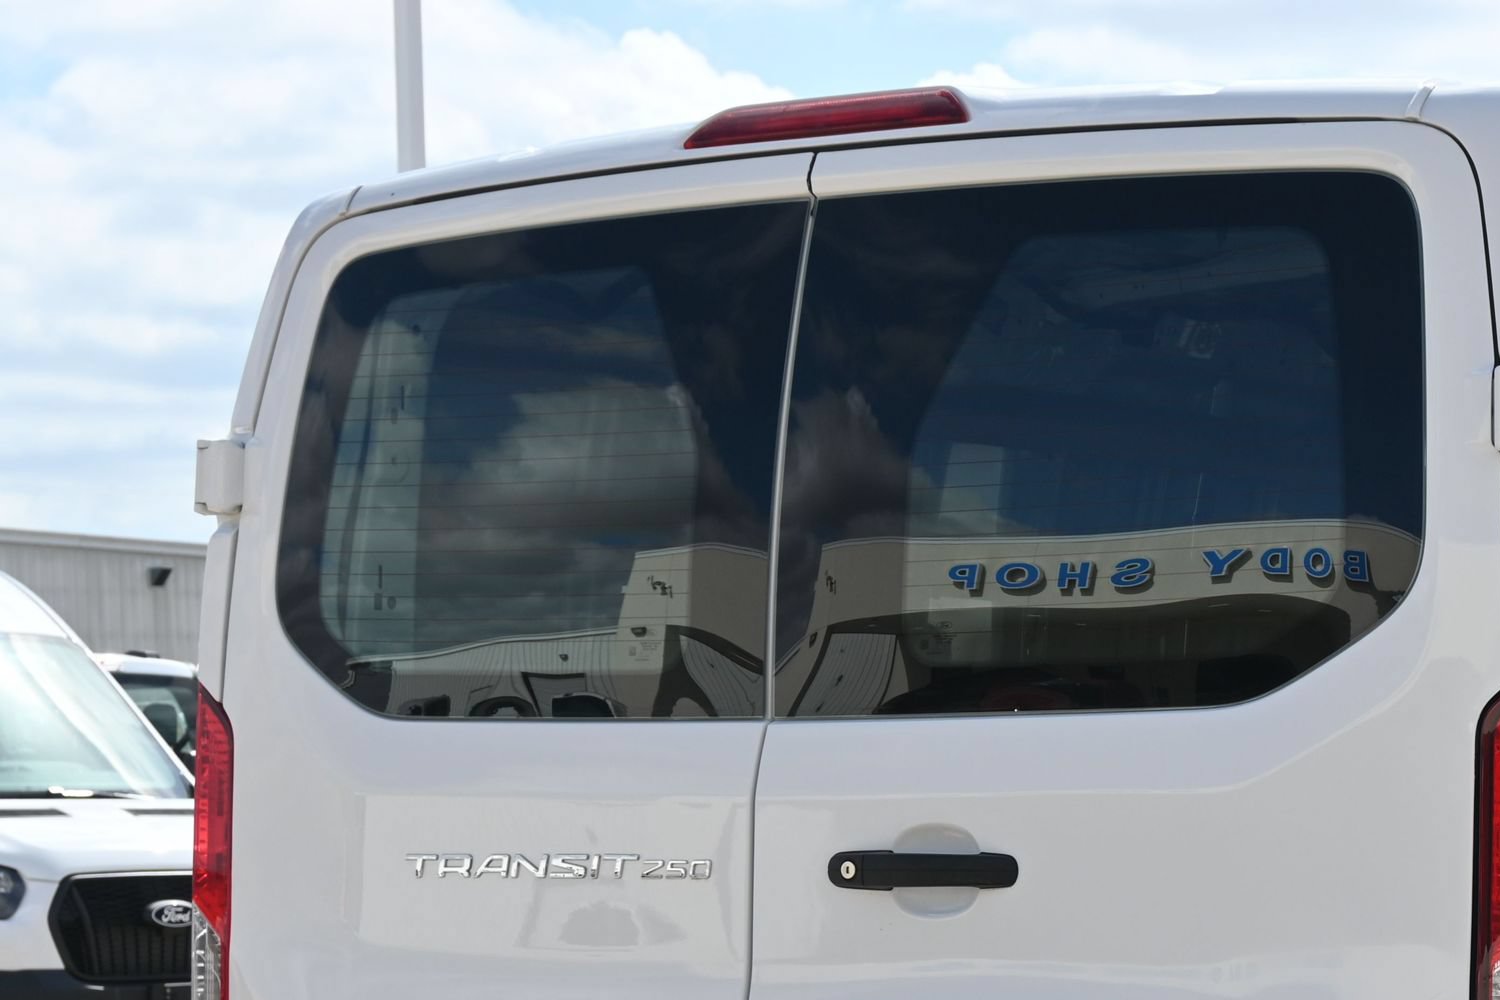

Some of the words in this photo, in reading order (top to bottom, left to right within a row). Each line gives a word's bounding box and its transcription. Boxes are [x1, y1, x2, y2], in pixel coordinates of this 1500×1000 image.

[404, 853, 640, 879] TRANSIT
[641, 859, 712, 879] 250
[161, 906, 191, 923] Ford
